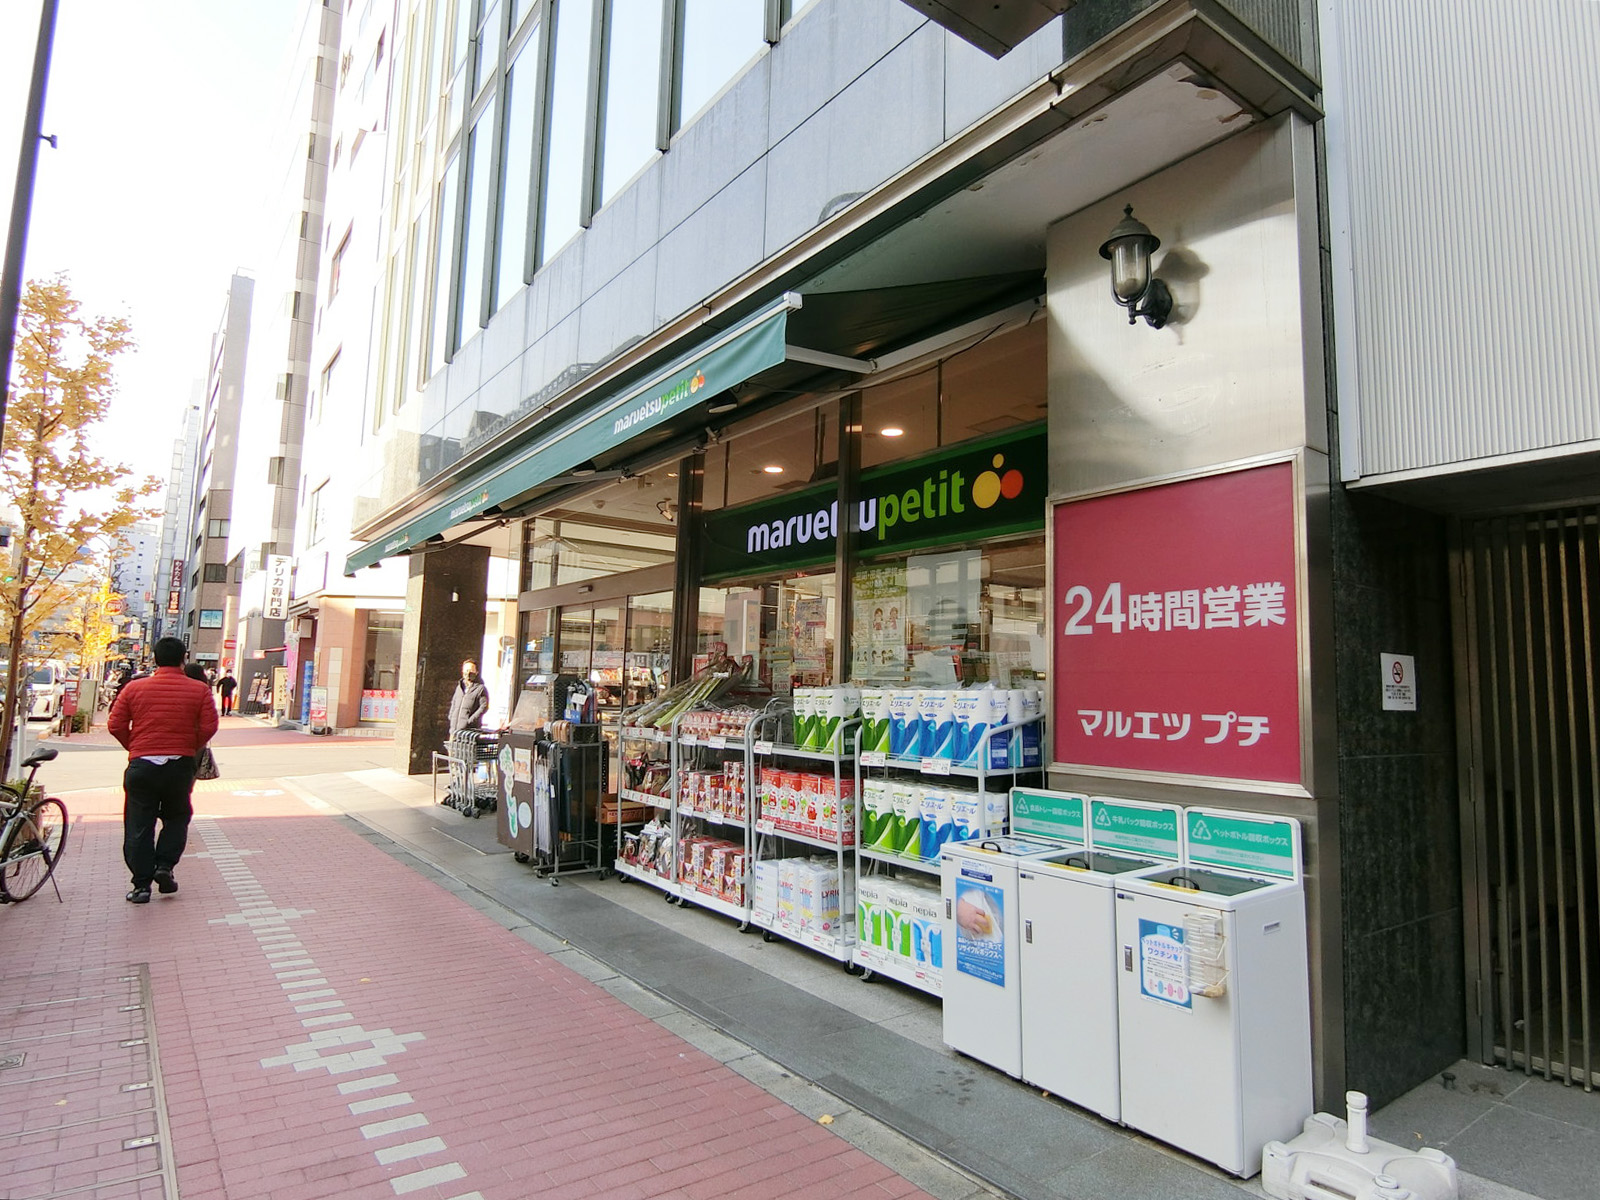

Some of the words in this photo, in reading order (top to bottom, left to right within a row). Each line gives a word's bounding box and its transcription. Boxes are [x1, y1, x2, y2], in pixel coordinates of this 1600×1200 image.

[613, 378, 690, 435] maruetsupetit
[747, 470, 965, 554] maruetupetit
[270, 557, 287, 617] デリカ専門店
[1064, 582, 1286, 635] 24時間営業
[920, 701, 944, 709] エリエール
[953, 702, 977, 710] エリエール
[1077, 710, 1191, 741] マルエツ
[1201, 711, 1270, 747] プチ
[920, 800, 944, 810] エリエール
[952, 804, 976, 814] エリエール
[1112, 815, 1174, 831] 牛乳パック回収ボックス
[1213, 829, 1288, 846] ペットボトル回収ボックス
[780, 880, 793, 891] LYRIC
[800, 887, 813, 898] LYRIC
[887, 895, 908, 909] nepia
[913, 904, 937, 918] nepia
